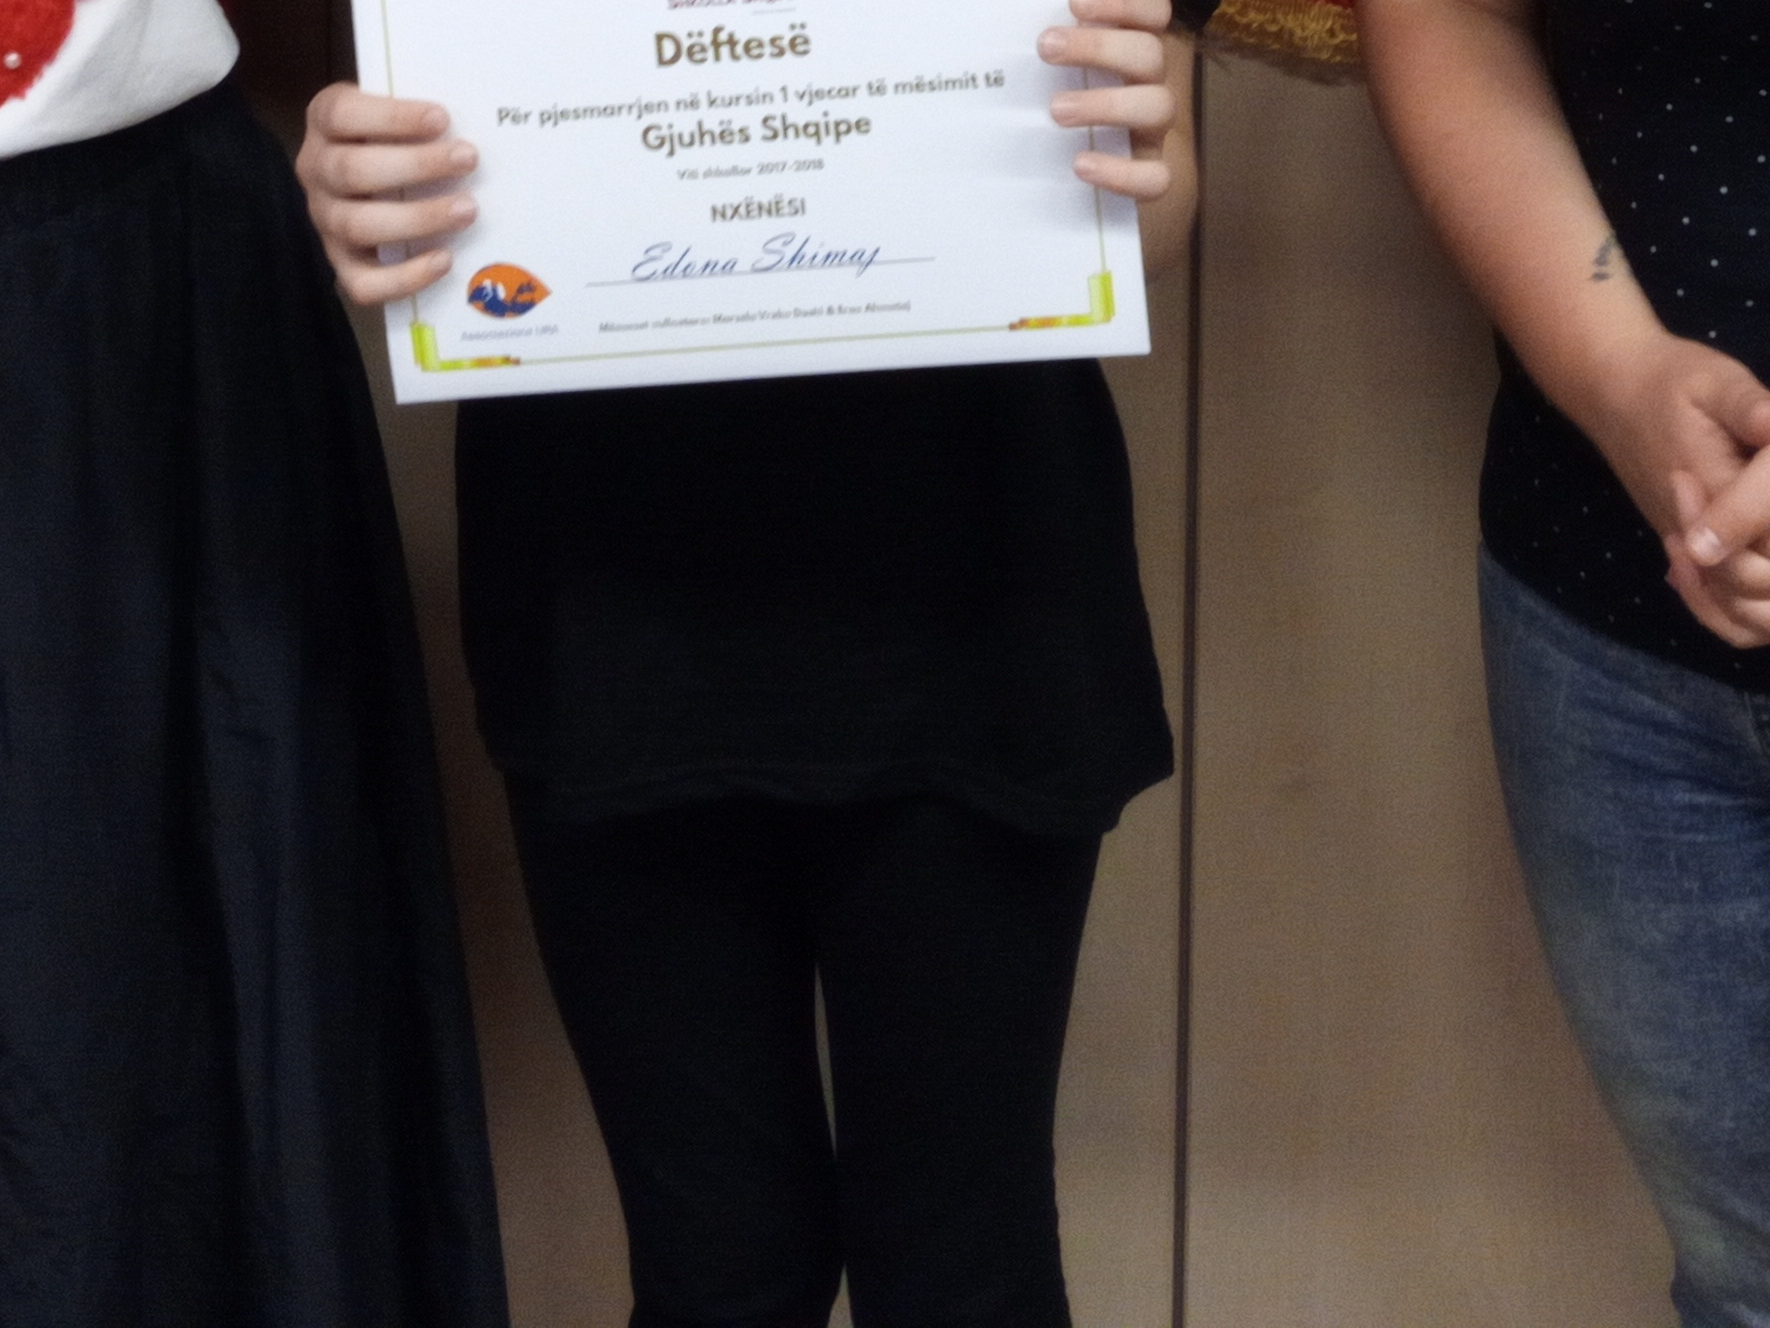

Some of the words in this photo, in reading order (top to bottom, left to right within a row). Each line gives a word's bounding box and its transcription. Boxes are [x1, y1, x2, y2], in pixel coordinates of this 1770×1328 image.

[655, 22, 812, 68] Dëftesë
[497, 105, 532, 126] Për
[539, 98, 669, 127] pjesmarrjen
[675, 92, 700, 111] në
[707, 83, 774, 109] kursin
[779, 84, 789, 103] 1
[866, 77, 887, 96] të
[893, 70, 979, 95] mësimit
[984, 69, 1006, 88] të
[641, 119, 752, 158] Gjuhës
[760, 110, 872, 145] Shqipe
[711, 192, 806, 223] NXËNËSI
